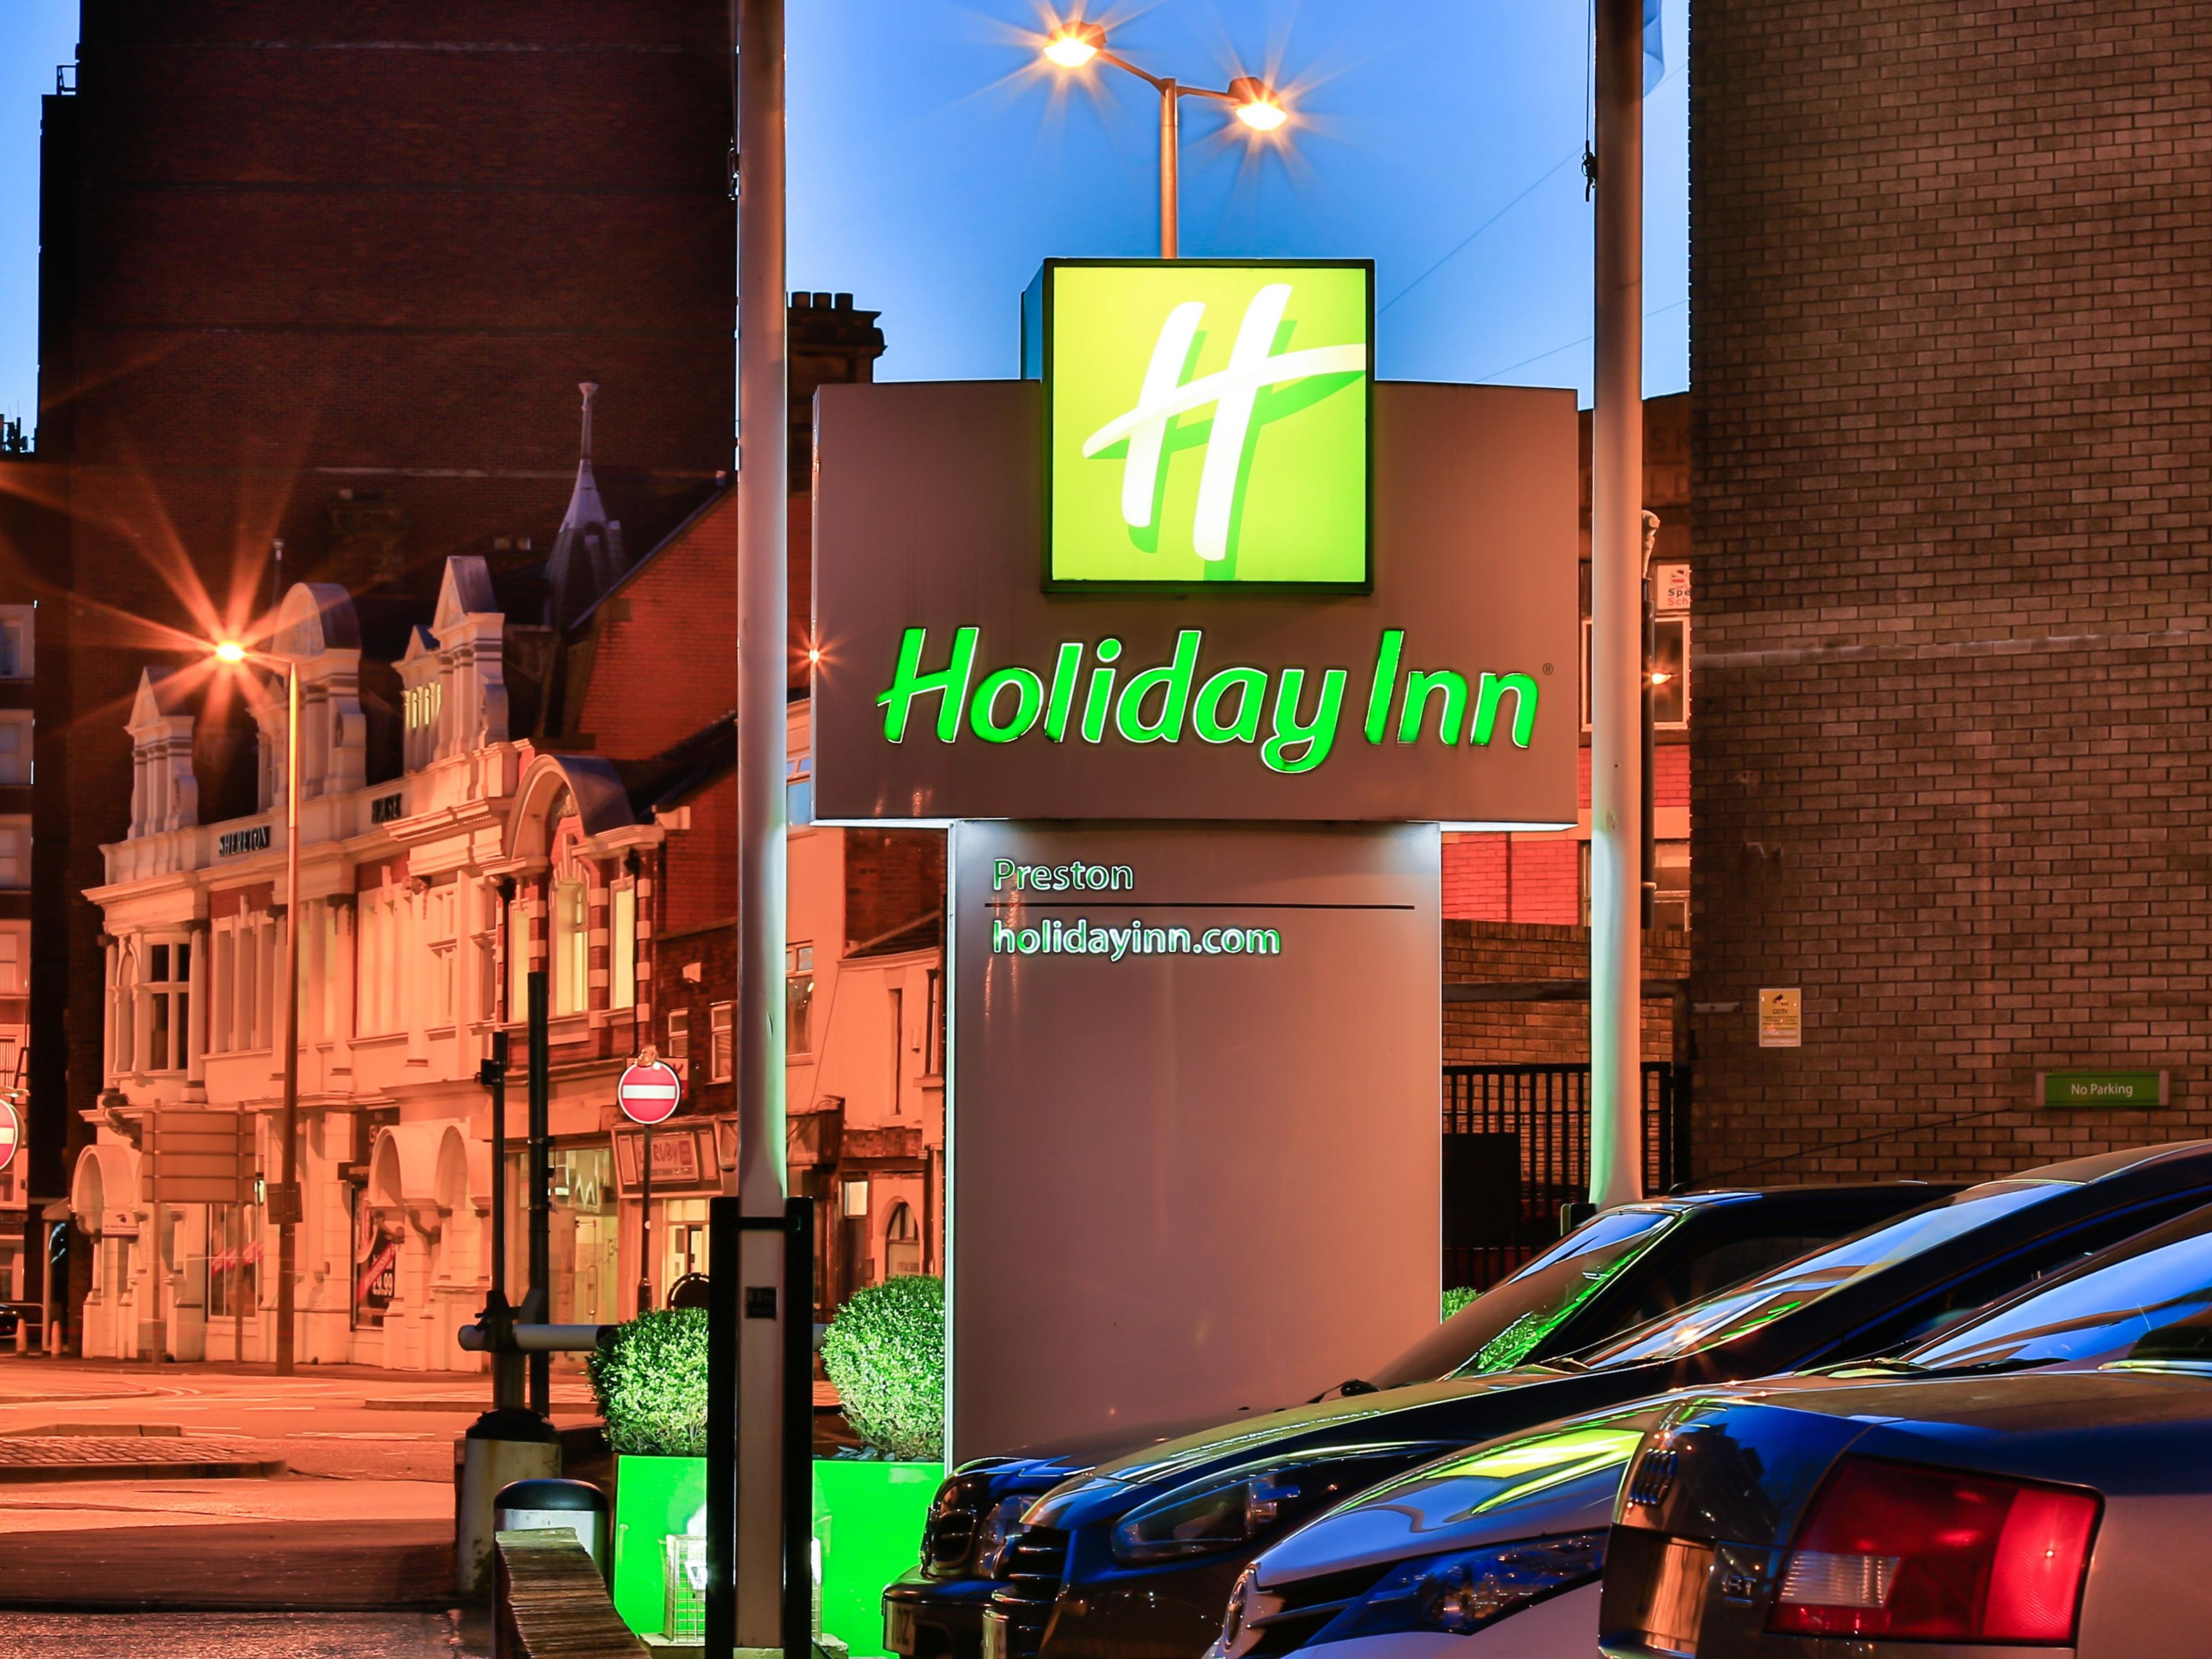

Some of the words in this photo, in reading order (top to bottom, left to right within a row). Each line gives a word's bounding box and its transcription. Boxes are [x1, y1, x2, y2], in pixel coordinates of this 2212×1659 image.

[877, 626, 1348, 774] Holiday
[1364, 629, 1540, 749] Inn
[993, 858, 1134, 891] Preston
[993, 919, 1281, 962] holidayinn.com
[2071, 1083, 2088, 1095] No
[2090, 1083, 2133, 1098] Parking
